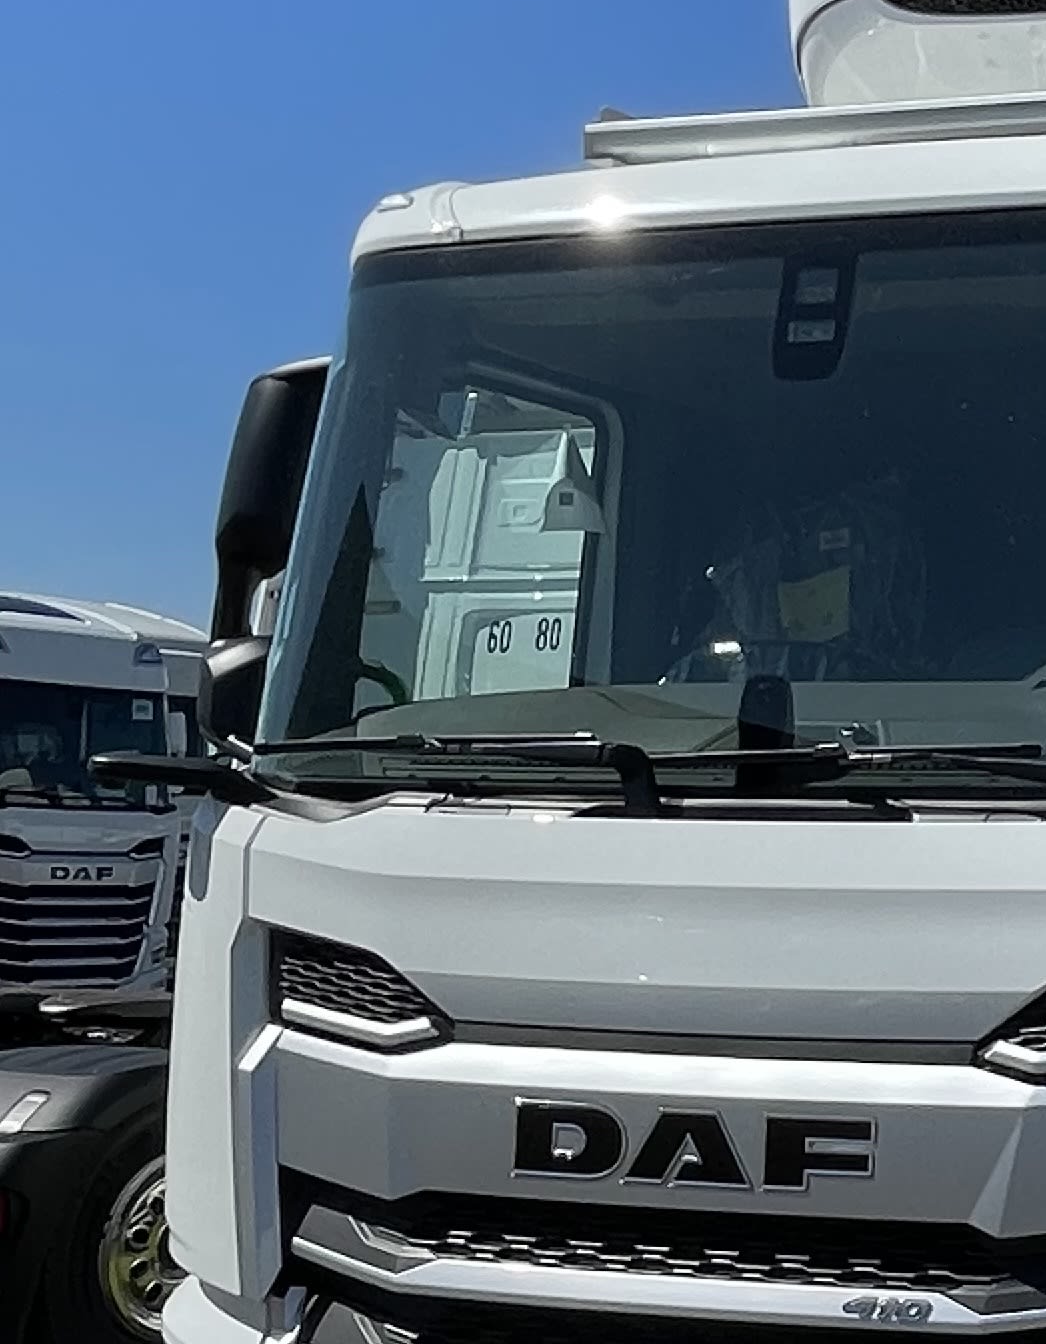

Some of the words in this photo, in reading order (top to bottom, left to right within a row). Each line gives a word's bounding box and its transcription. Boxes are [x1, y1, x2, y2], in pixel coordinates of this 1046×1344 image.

[487, 620, 512, 654] 60
[535, 617, 562, 651] 80
[50, 866, 114, 881] DAF
[510, 1096, 879, 1192] DAF
[842, 1296, 934, 1325] 410
